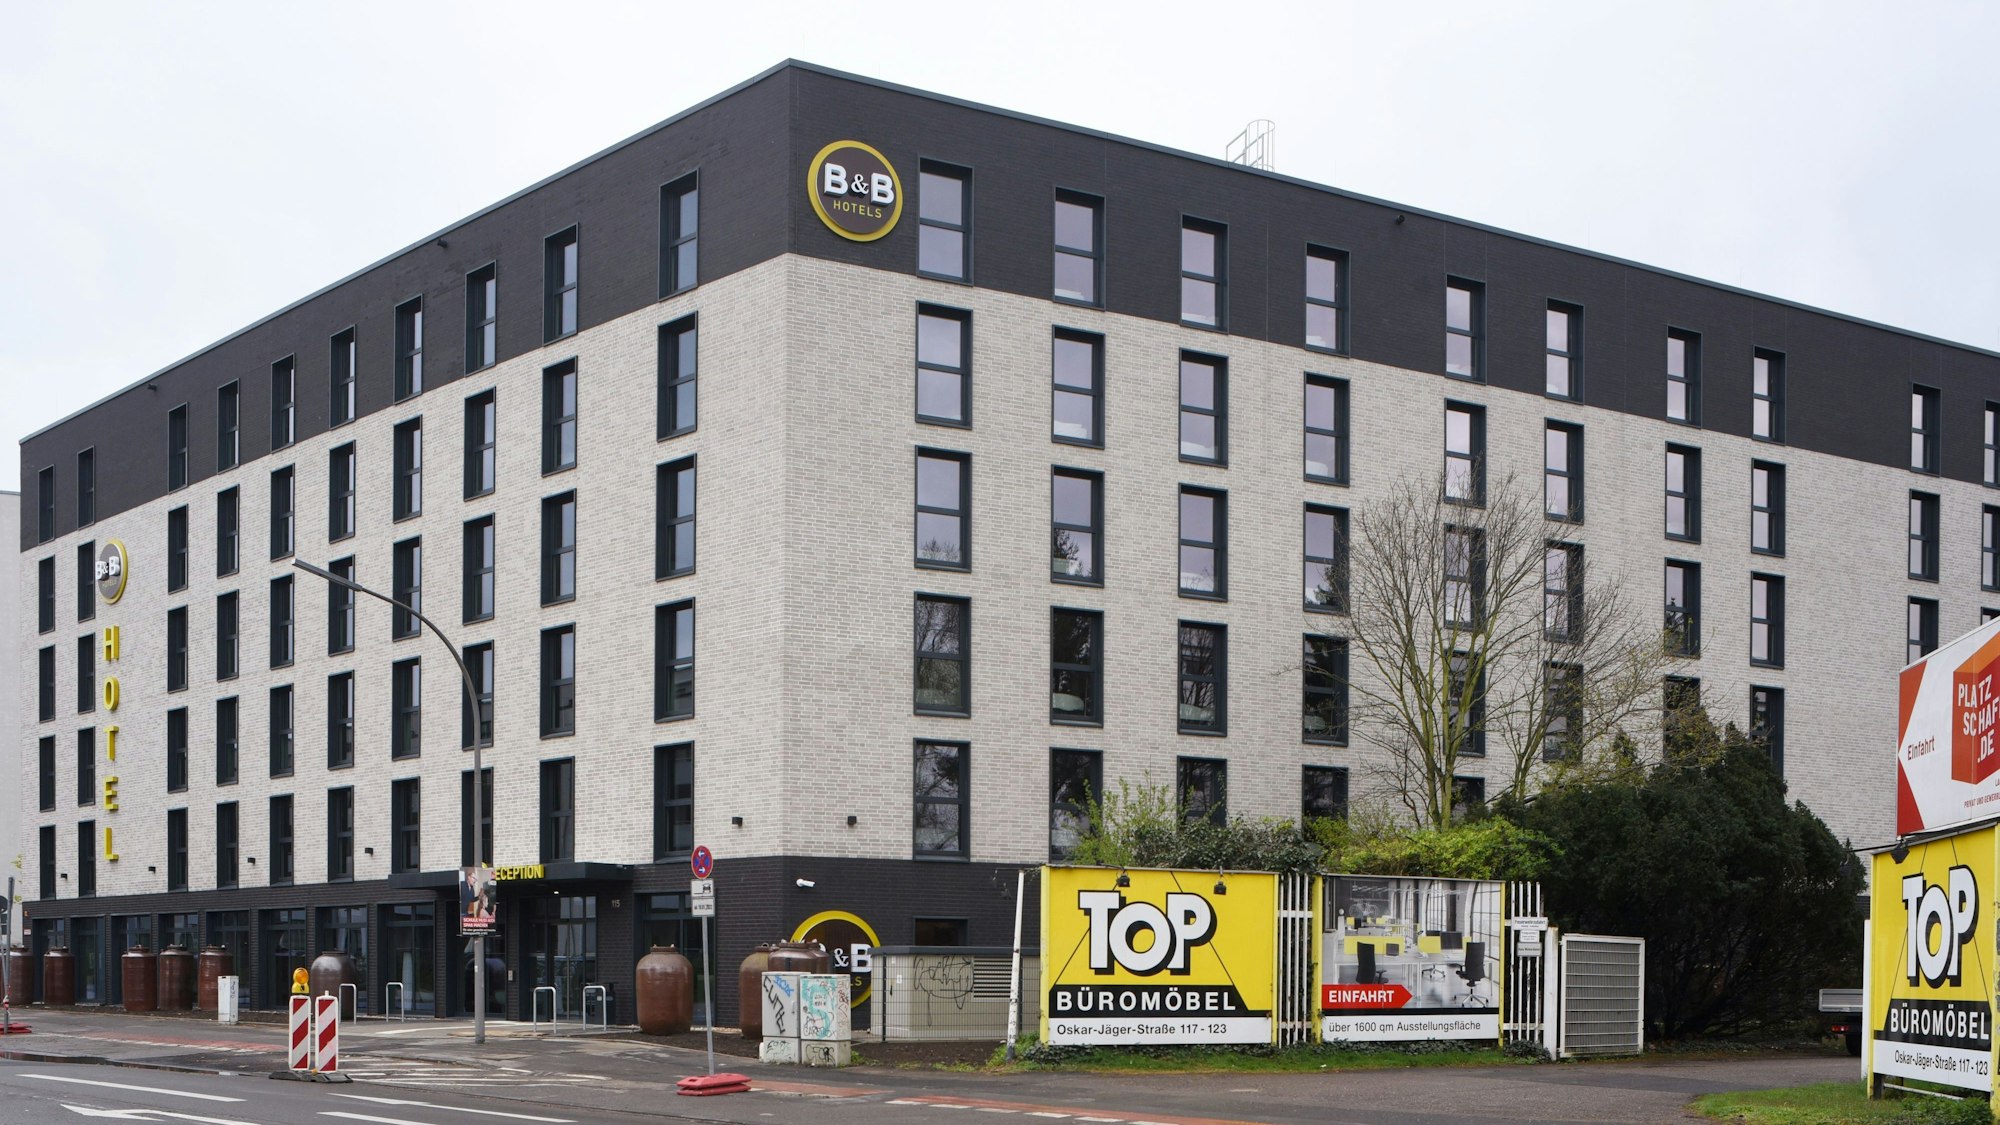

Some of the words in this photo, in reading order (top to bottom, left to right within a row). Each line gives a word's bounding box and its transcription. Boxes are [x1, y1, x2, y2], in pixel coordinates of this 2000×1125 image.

[824, 162, 895, 206] B&B
[833, 200, 882, 219] HOTELS
[1958, 674, 1992, 708] PLATZ
[1963, 696, 2000, 736] SCHAF
[104, 625, 120, 863] HOTEL
[1907, 735, 1935, 761] Einfahrt
[496, 864, 544, 880] ECEPTION
[611, 899, 621, 909] 115
[1056, 986, 1236, 1012] BÜROMÖBEL
[1328, 990, 1395, 1003] EINFAHRT
[1057, 1024, 1176, 1036] Oskar-Jäger-Straße
[1180, 1024, 1198, 1035] 117
[1208, 1024, 1227, 1034] 123
[1329, 1022, 1351, 1032] über
[1355, 1022, 1376, 1032] 1600
[1379, 1024, 1394, 1034] qm
[1397, 1021, 1481, 1033] Ausstellungsfläche
[1890, 1002, 1989, 1040] BÜROMÖBEL
[1894, 1050, 1956, 1071] Oskar-Jäger-Straße
[1959, 1058, 1970, 1073] 117
[1975, 1060, 1988, 1076] 123
